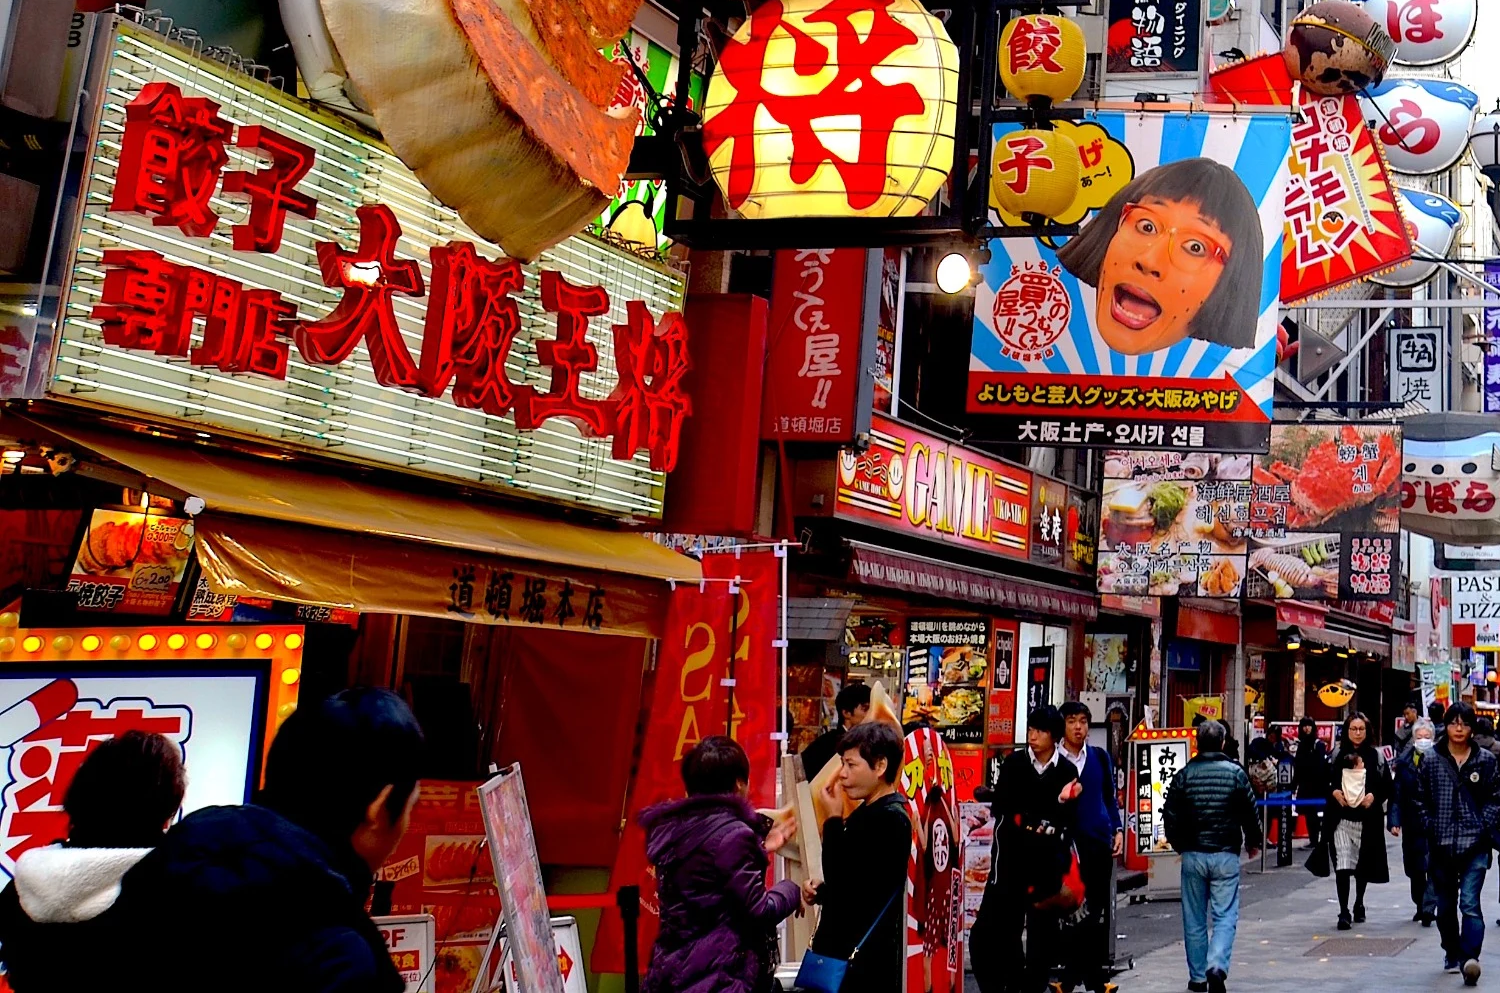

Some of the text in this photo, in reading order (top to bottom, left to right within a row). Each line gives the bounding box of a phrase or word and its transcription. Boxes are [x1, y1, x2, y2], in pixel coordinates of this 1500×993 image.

[110, 81, 319, 256] 餃子
[1293, 107, 1362, 252] コナモン
[290, 202, 693, 474] 大阪王将
[976, 383, 1240, 412] よしもと芸人グッズ・大阪みやげ
[1401, 377, 1433, 402] 焼
[1170, 424, 1205, 447] 선물
[905, 441, 994, 543] GAME
[1195, 504, 1288, 526] 해선호프집
[446, 564, 607, 631] 道頓堀本店
[909, 634, 986, 645] 本場大阪のお好み焼き
